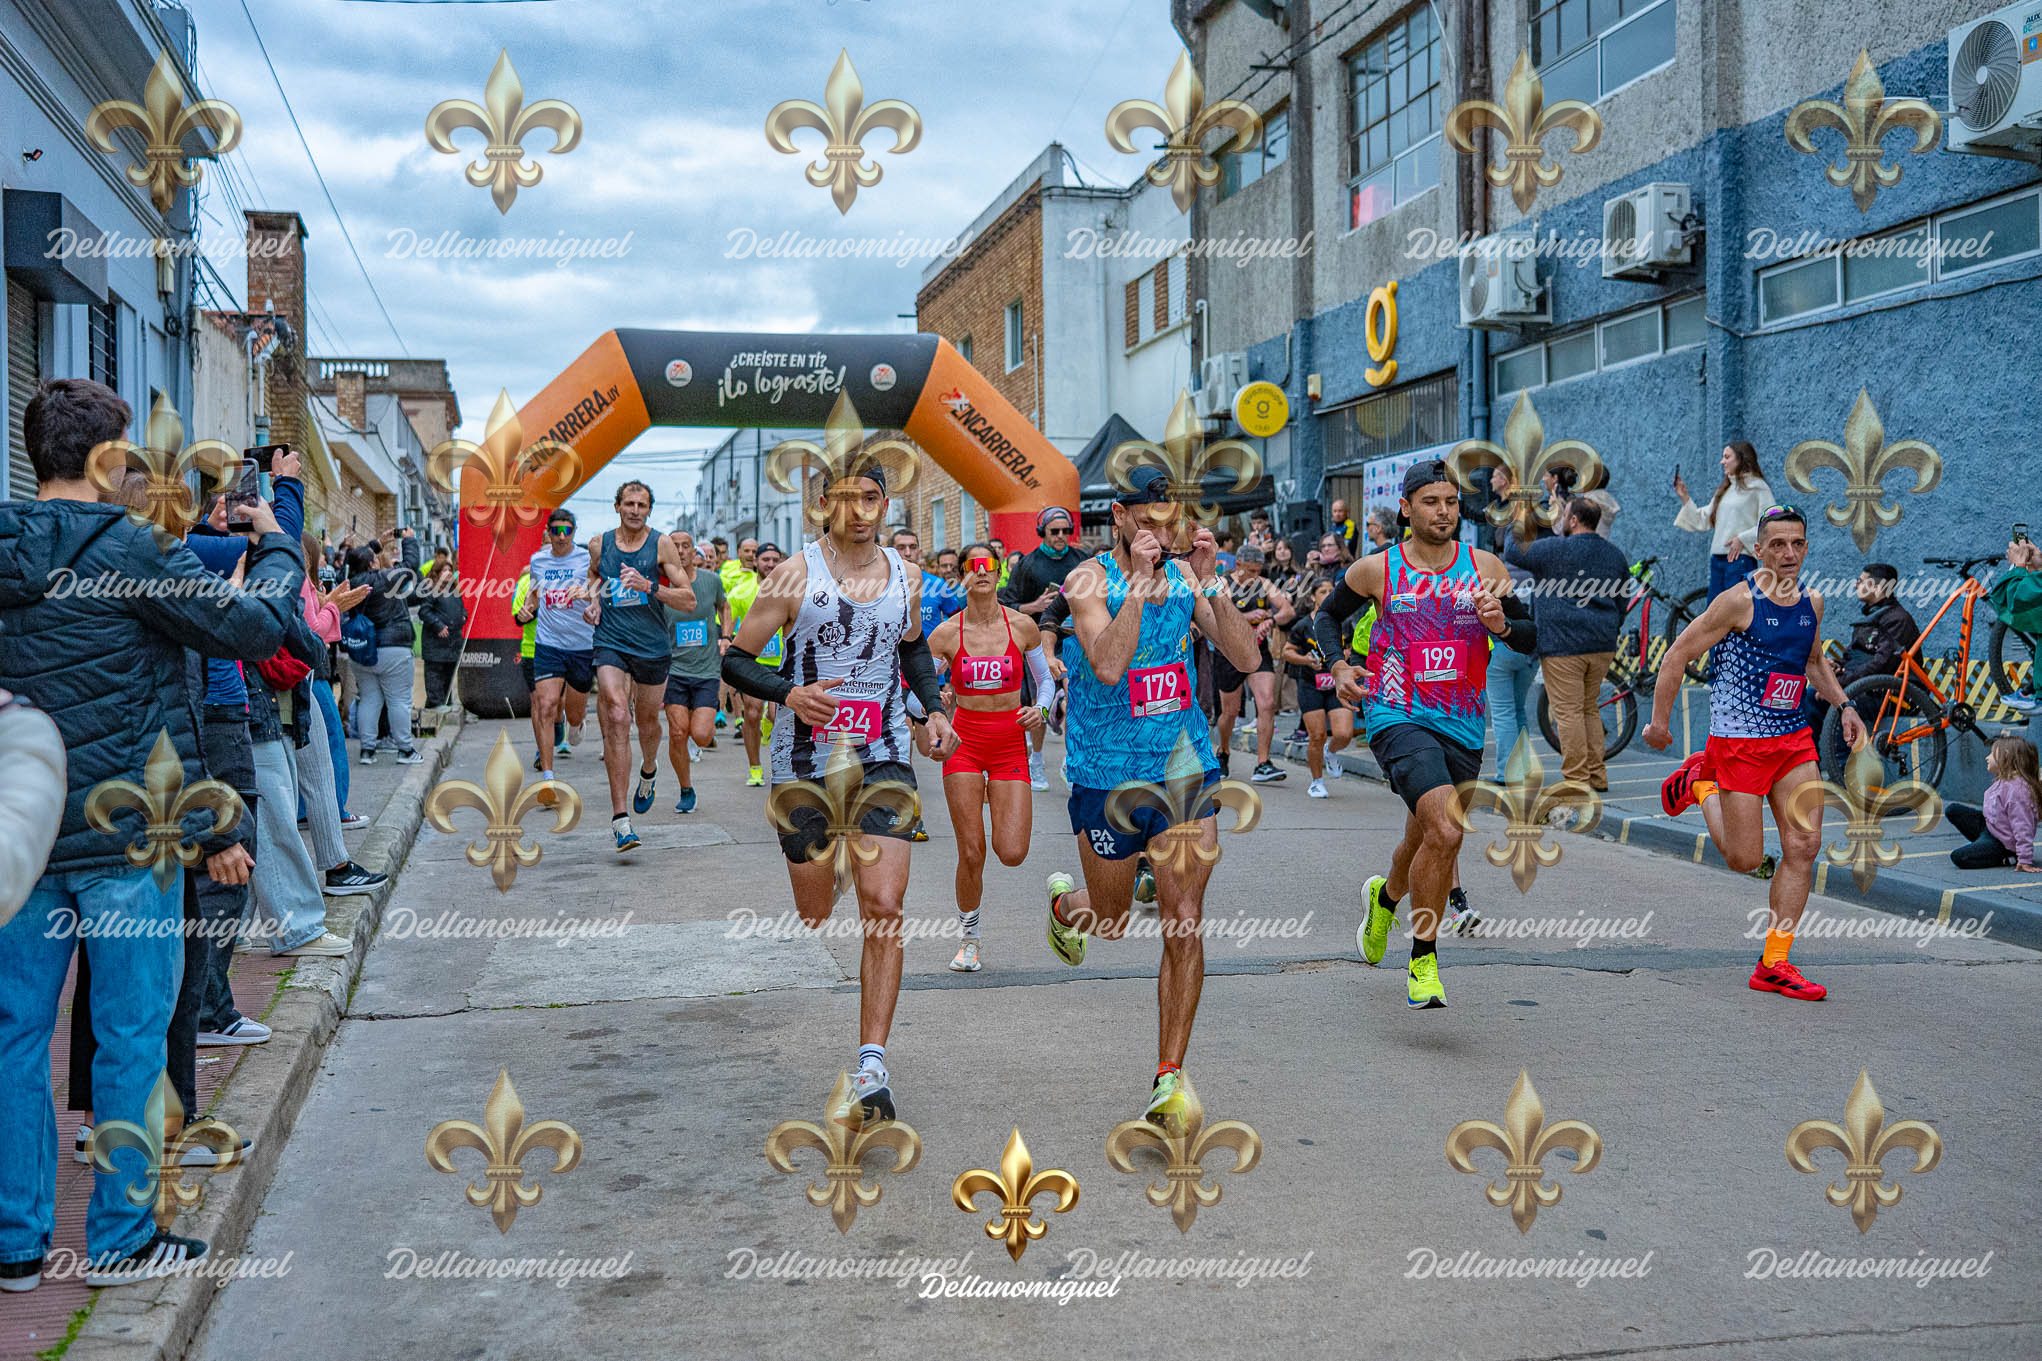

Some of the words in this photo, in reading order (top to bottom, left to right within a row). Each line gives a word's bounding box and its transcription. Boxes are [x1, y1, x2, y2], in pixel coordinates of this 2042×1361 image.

[730, 350, 787, 369] ¿CREÍSTE
[789, 353, 806, 367] EN
[808, 351, 827, 367] TÍ?
[755, 365, 847, 404] lograste!
[681, 628, 703, 641] 378
[1422, 646, 1456, 670] 199
[971, 660, 1002, 680] 178
[1143, 671, 1178, 701] 179
[1320, 675, 1336, 688] 22
[1771, 678, 1801, 700] 207
[823, 706, 871, 733] 234
